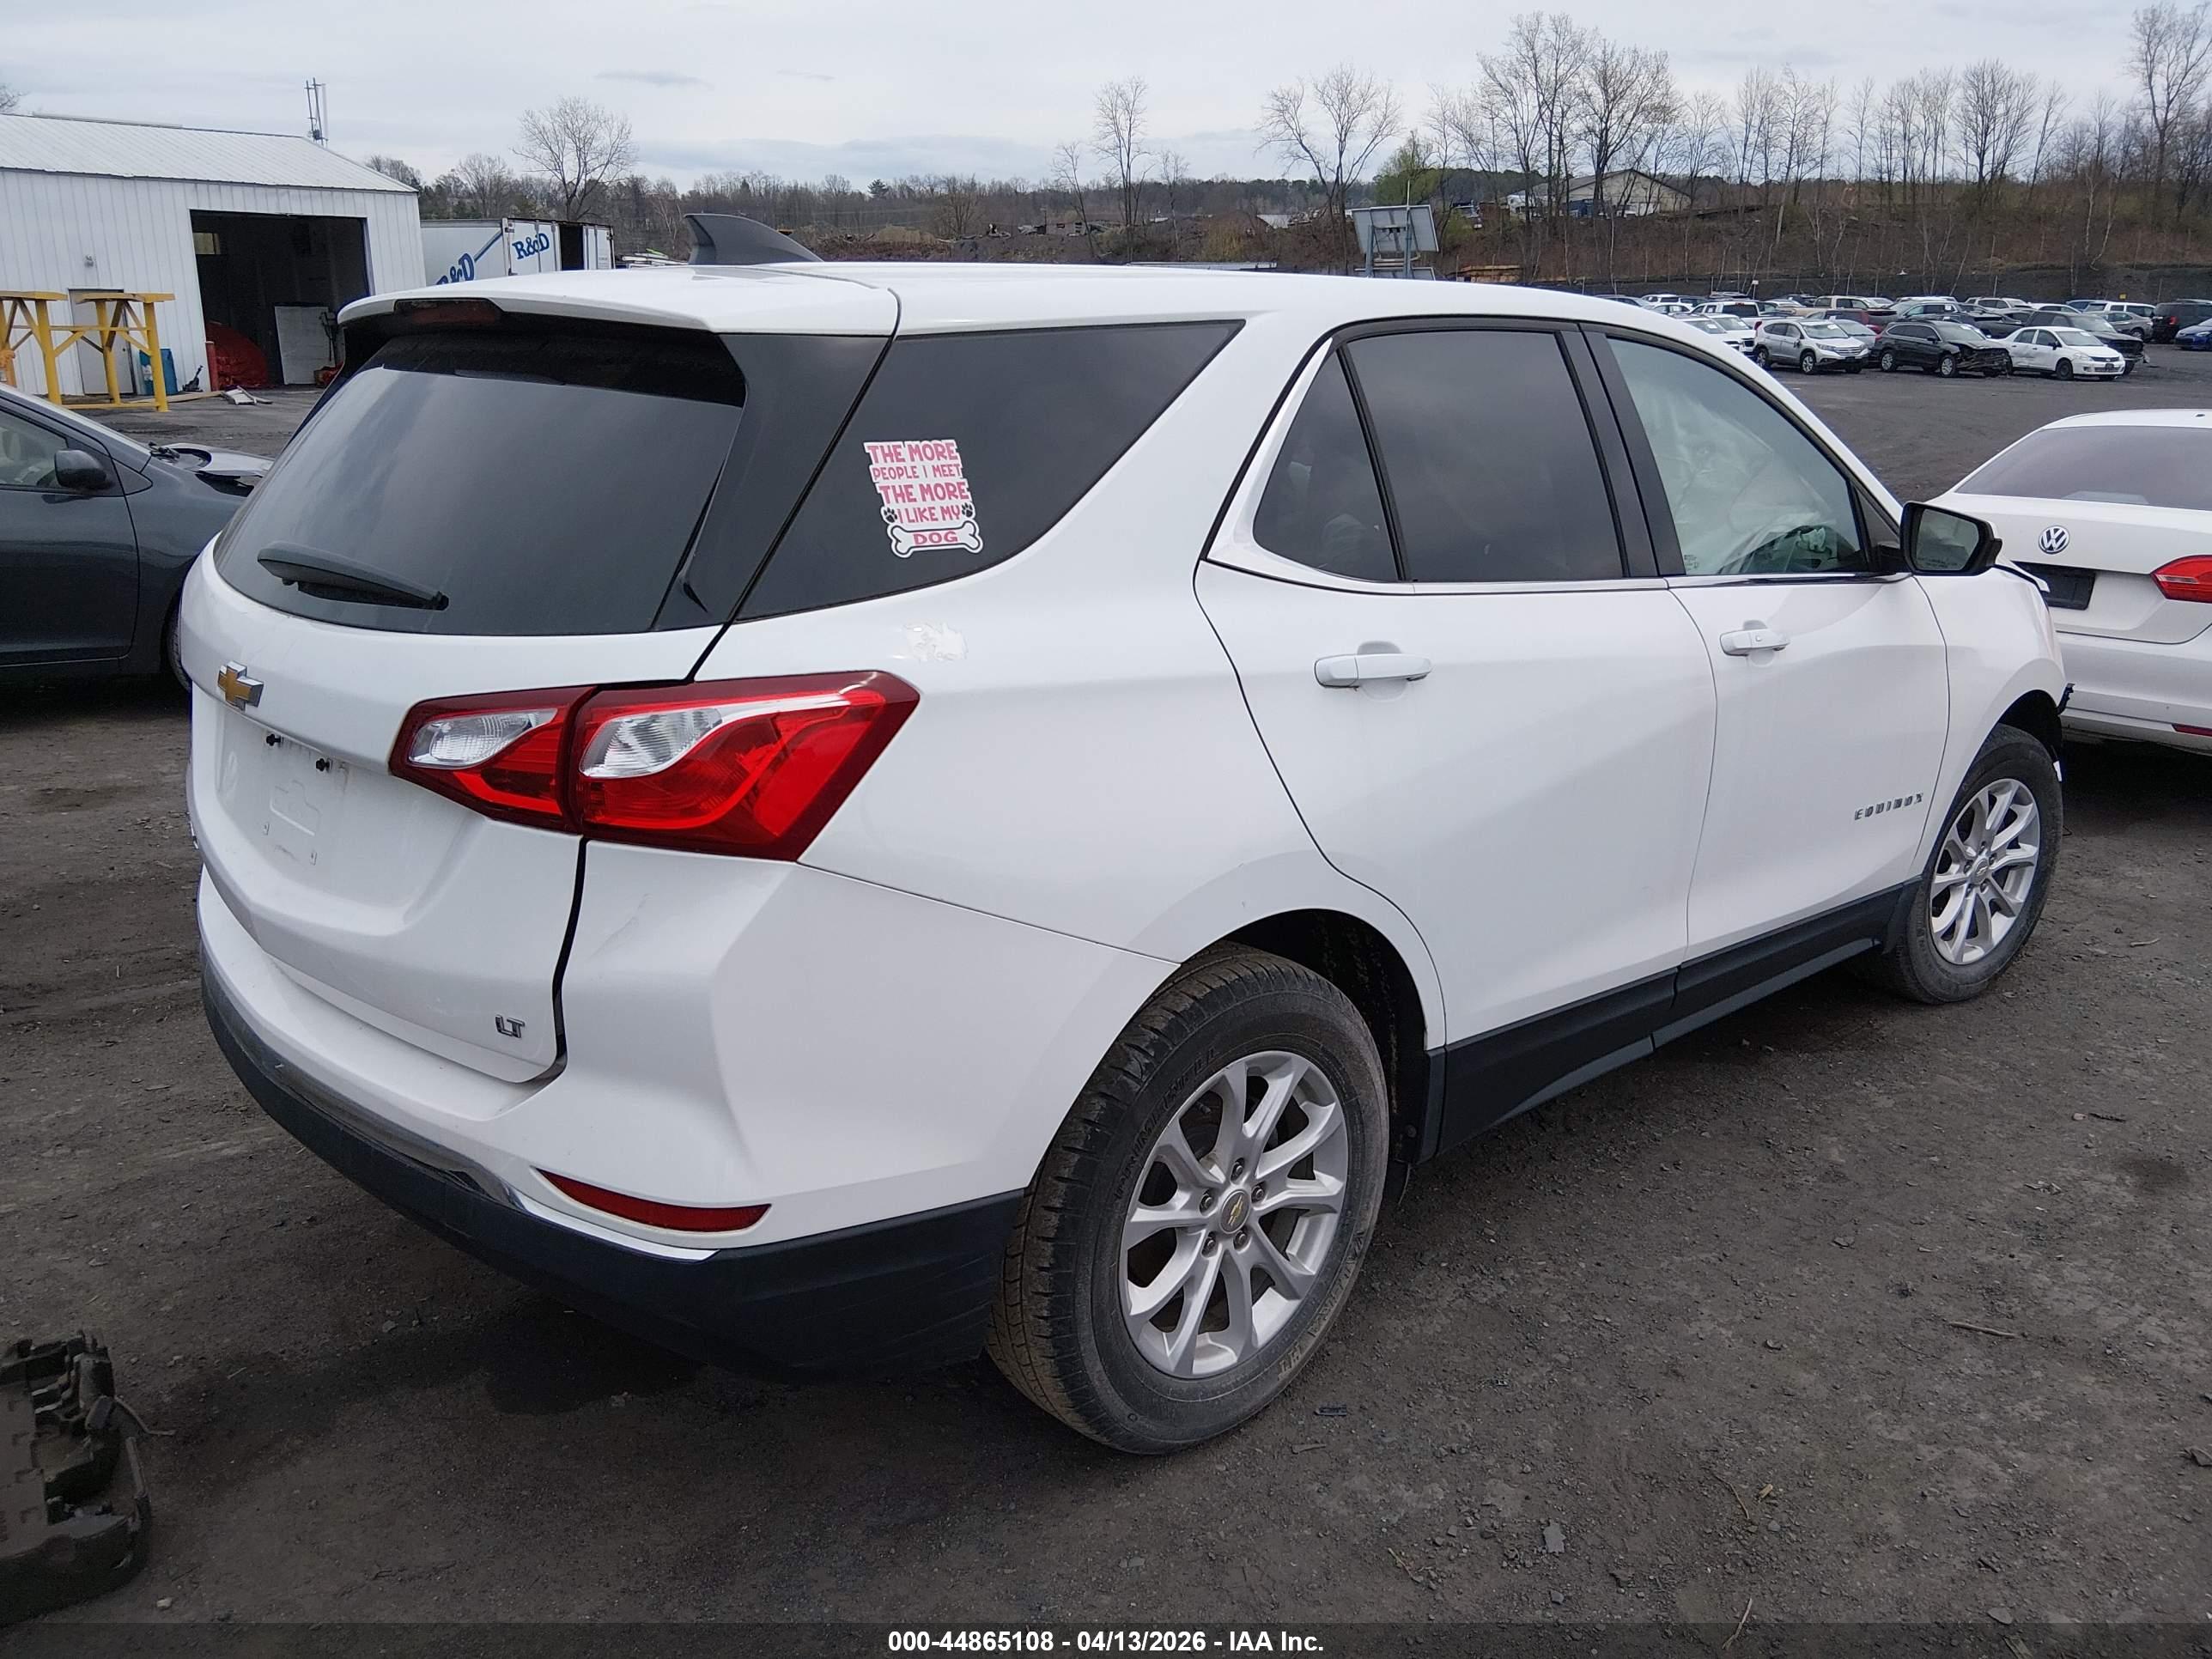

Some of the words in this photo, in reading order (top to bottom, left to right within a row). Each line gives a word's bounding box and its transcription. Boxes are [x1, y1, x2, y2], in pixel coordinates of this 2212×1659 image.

[511, 232, 550, 260] R&D
[867, 444, 906, 464] THE
[908, 442, 959, 462] MORE
[872, 465, 920, 481] PEOPLE
[923, 465, 928, 479] I
[932, 464, 962, 477] MEET
[878, 484, 917, 504] THE
[919, 482, 969, 502] MORE
[897, 508, 904, 524] I
[904, 507, 939, 524] LIKE
[940, 505, 961, 521] MY
[913, 531, 958, 545] DOG
[1854, 793, 1923, 821] EQUINOX
[495, 1014, 526, 1038] LT
